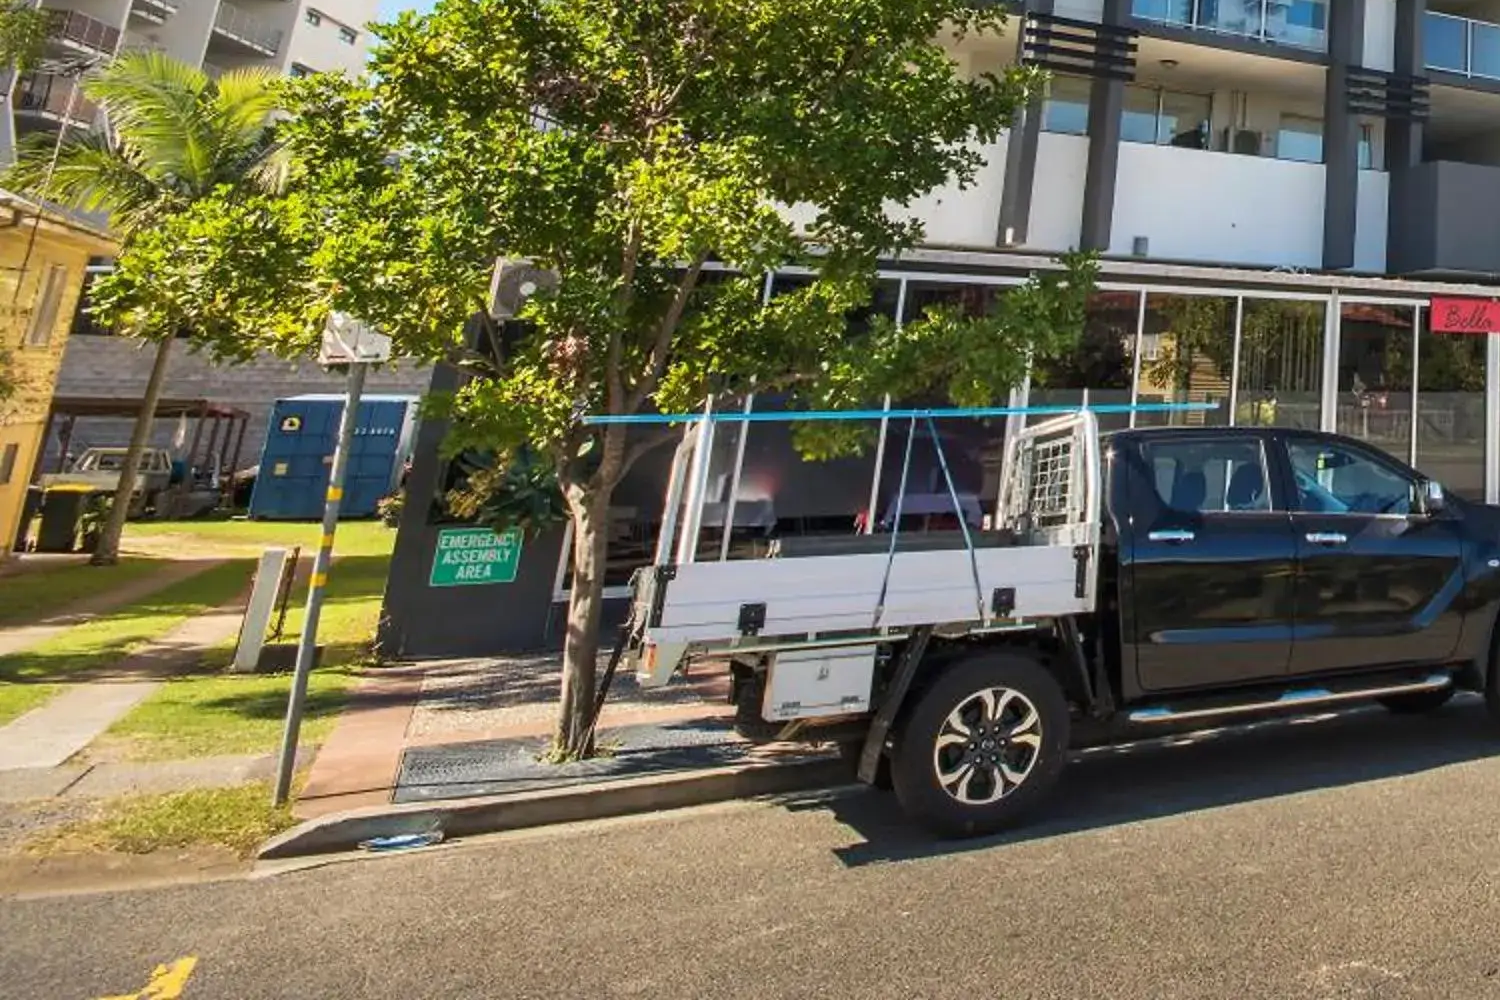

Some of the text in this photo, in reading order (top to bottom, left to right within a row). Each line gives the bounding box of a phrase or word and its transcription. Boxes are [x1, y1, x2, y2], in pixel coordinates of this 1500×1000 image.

[1444, 305, 1492, 329] Bella
[442, 547, 512, 565] ASSEMBLY
[455, 563, 492, 580] AREA
